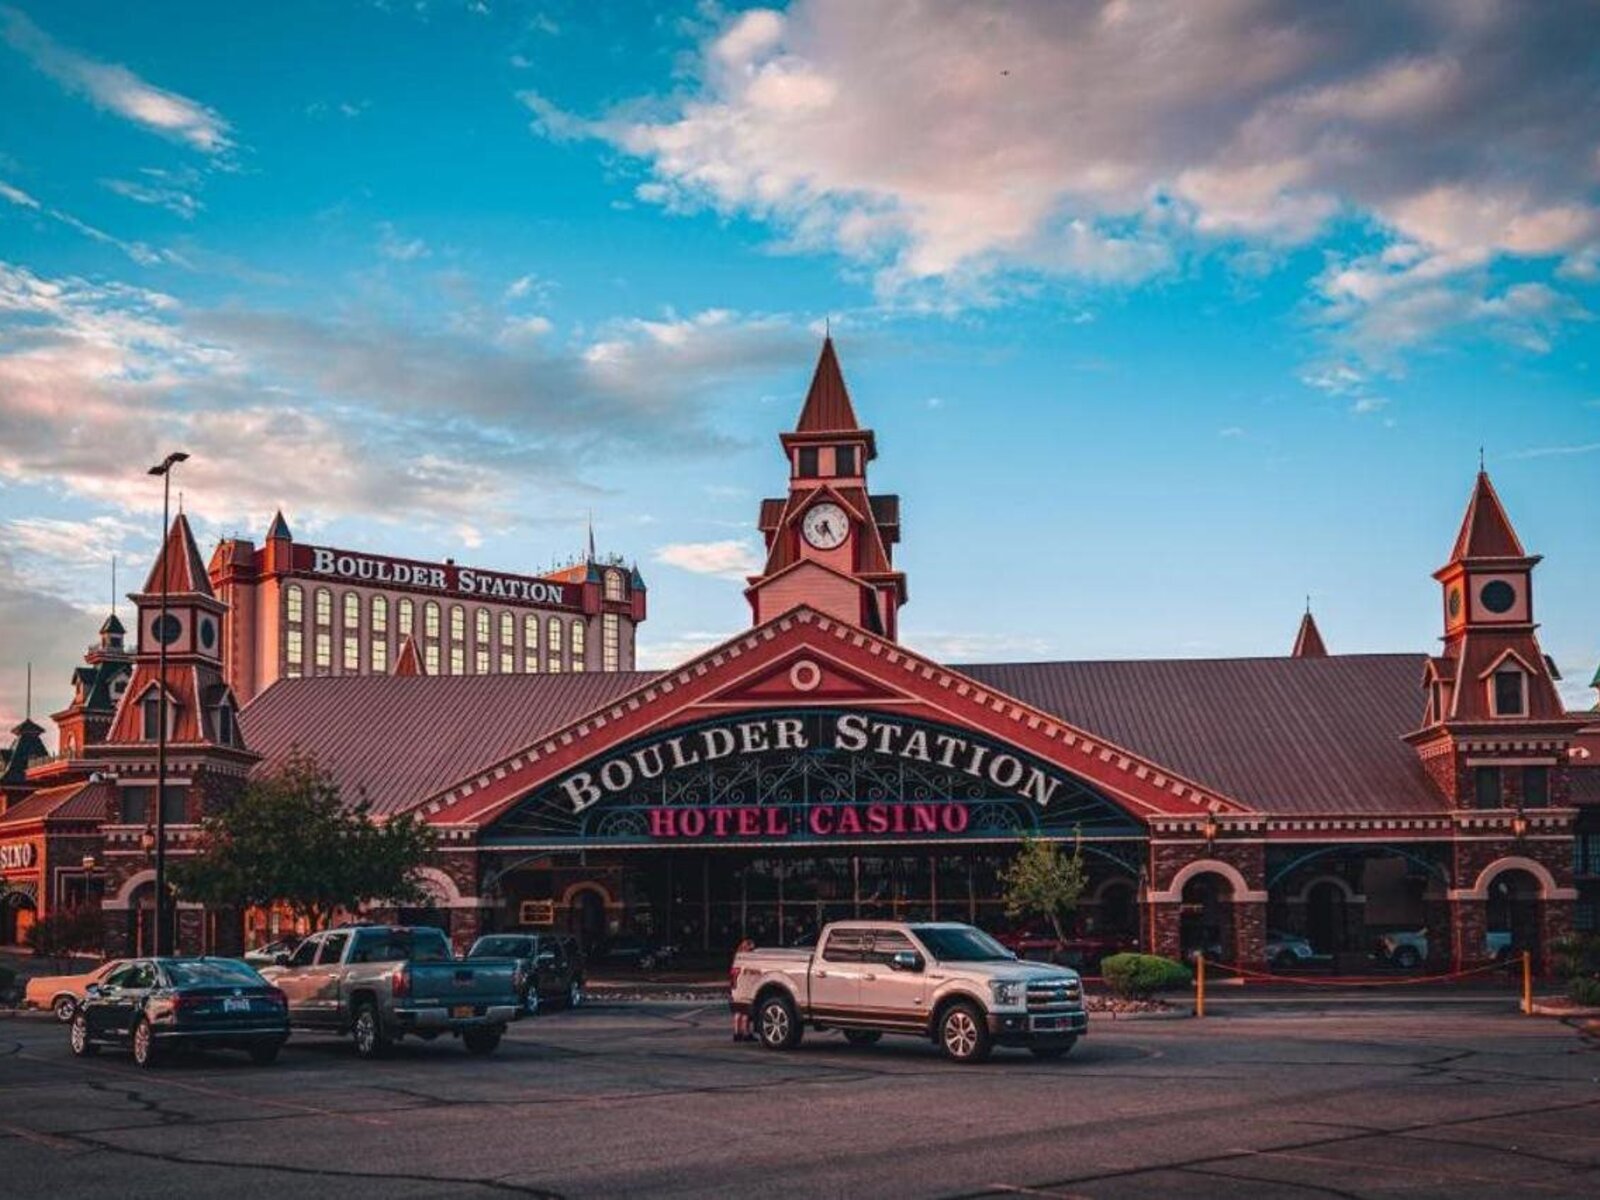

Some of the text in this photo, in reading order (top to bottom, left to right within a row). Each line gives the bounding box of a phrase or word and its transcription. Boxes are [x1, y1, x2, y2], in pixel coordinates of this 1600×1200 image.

[313, 549, 563, 604] BOULDER STATION
[559, 713, 1062, 814] BOULDER STATION
[651, 803, 969, 837] HOTEL CASINO
